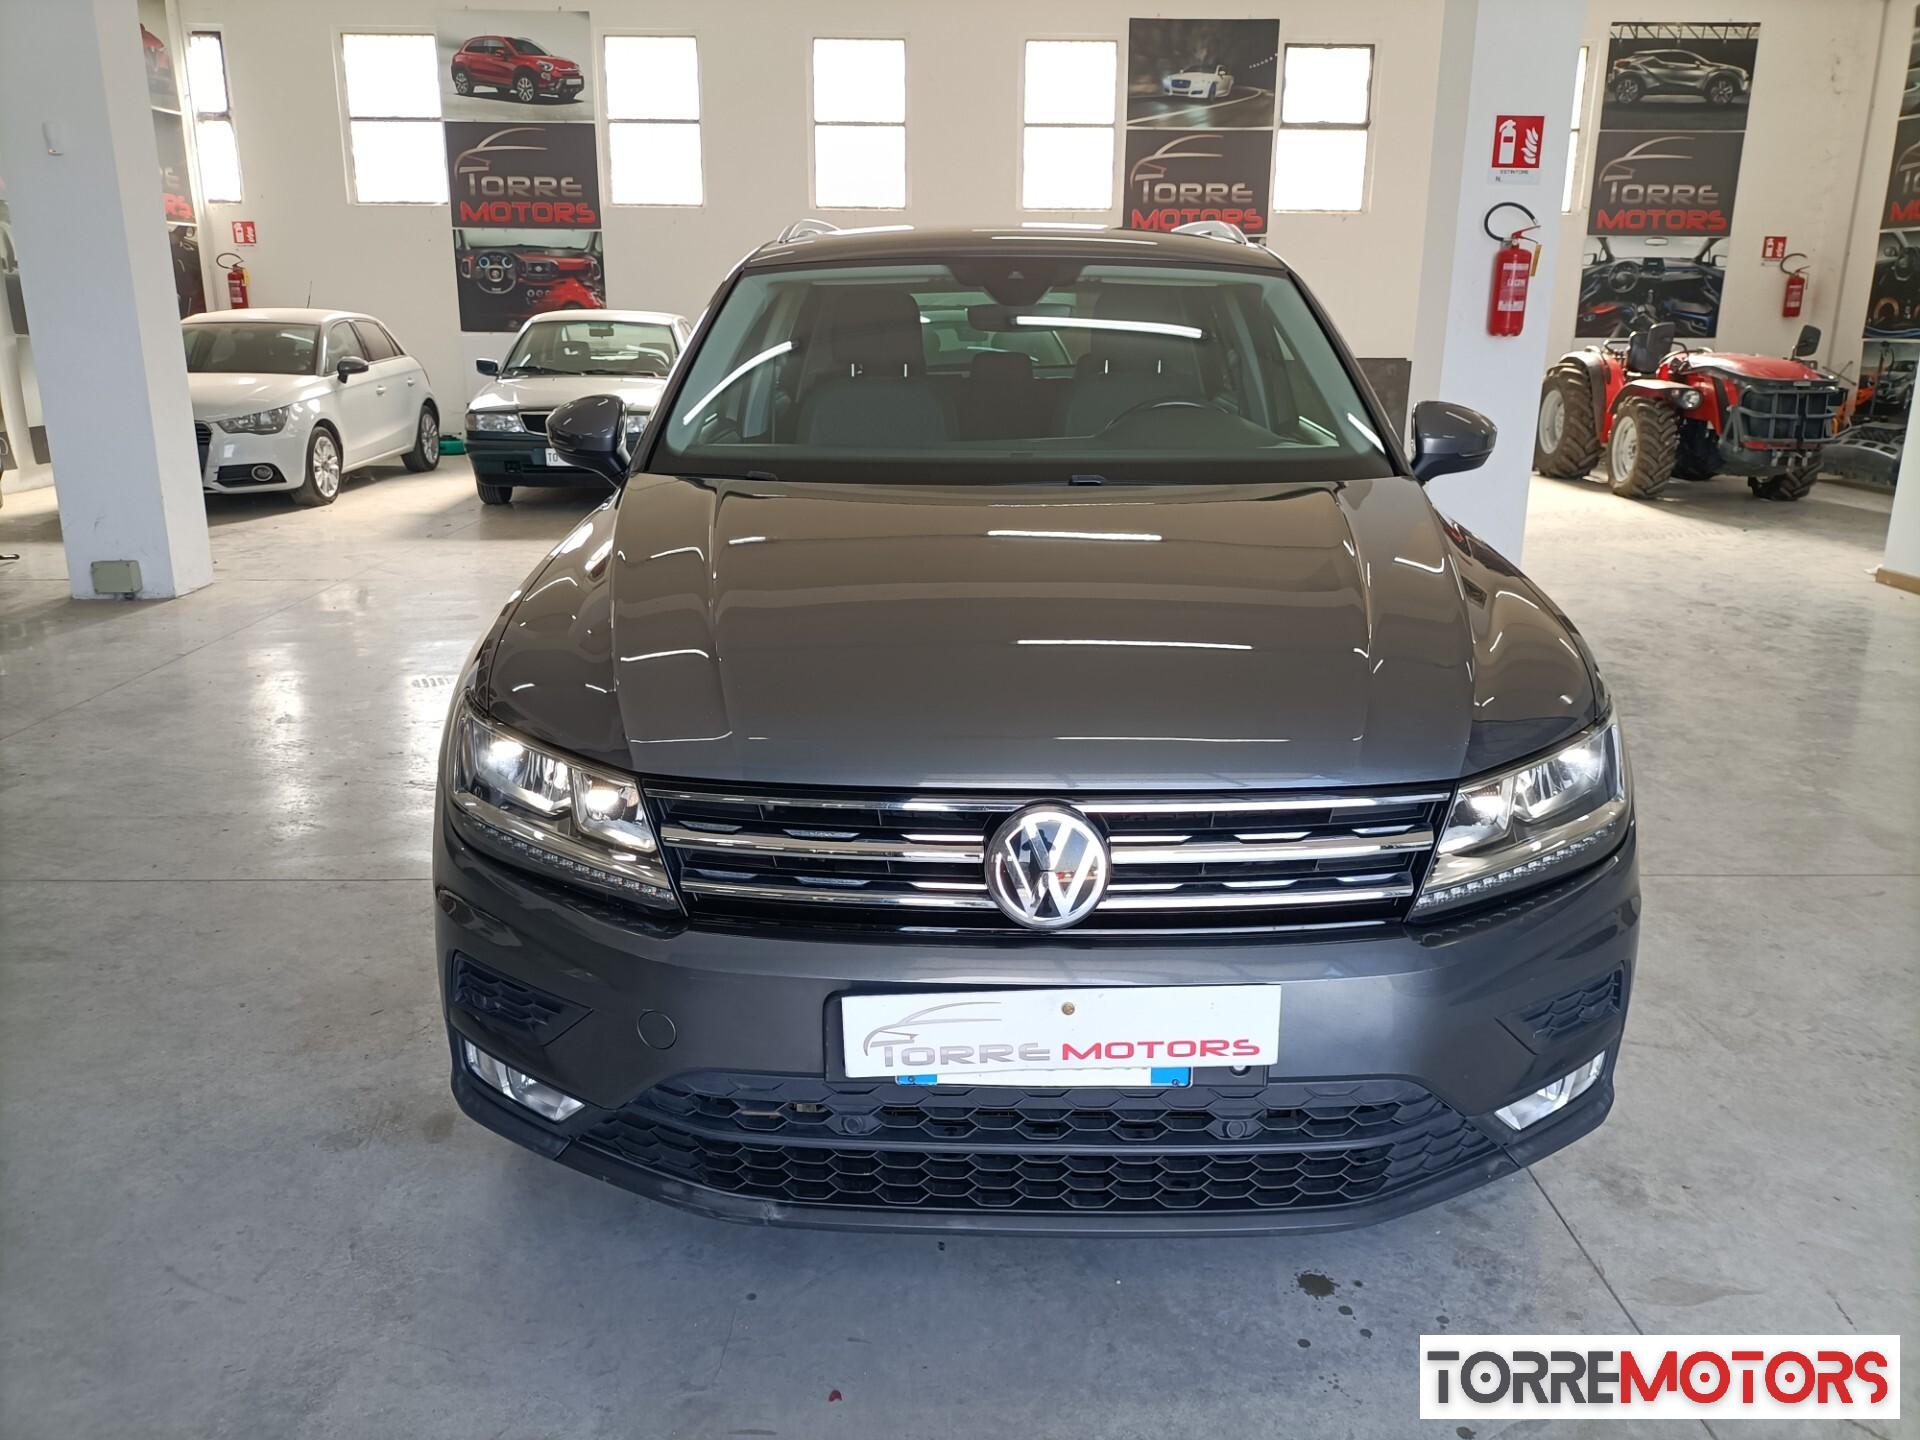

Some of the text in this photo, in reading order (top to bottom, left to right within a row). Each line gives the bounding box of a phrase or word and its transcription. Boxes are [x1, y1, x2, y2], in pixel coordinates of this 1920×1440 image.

[458, 166, 583, 197] TORRE
[1134, 173, 1254, 203] TORRE
[1602, 174, 1720, 205] TORRE
[459, 201, 597, 224] MOTORS
[1596, 208, 1728, 231] MOTORS
[869, 1038, 1261, 1068] TORRE MOTORS
